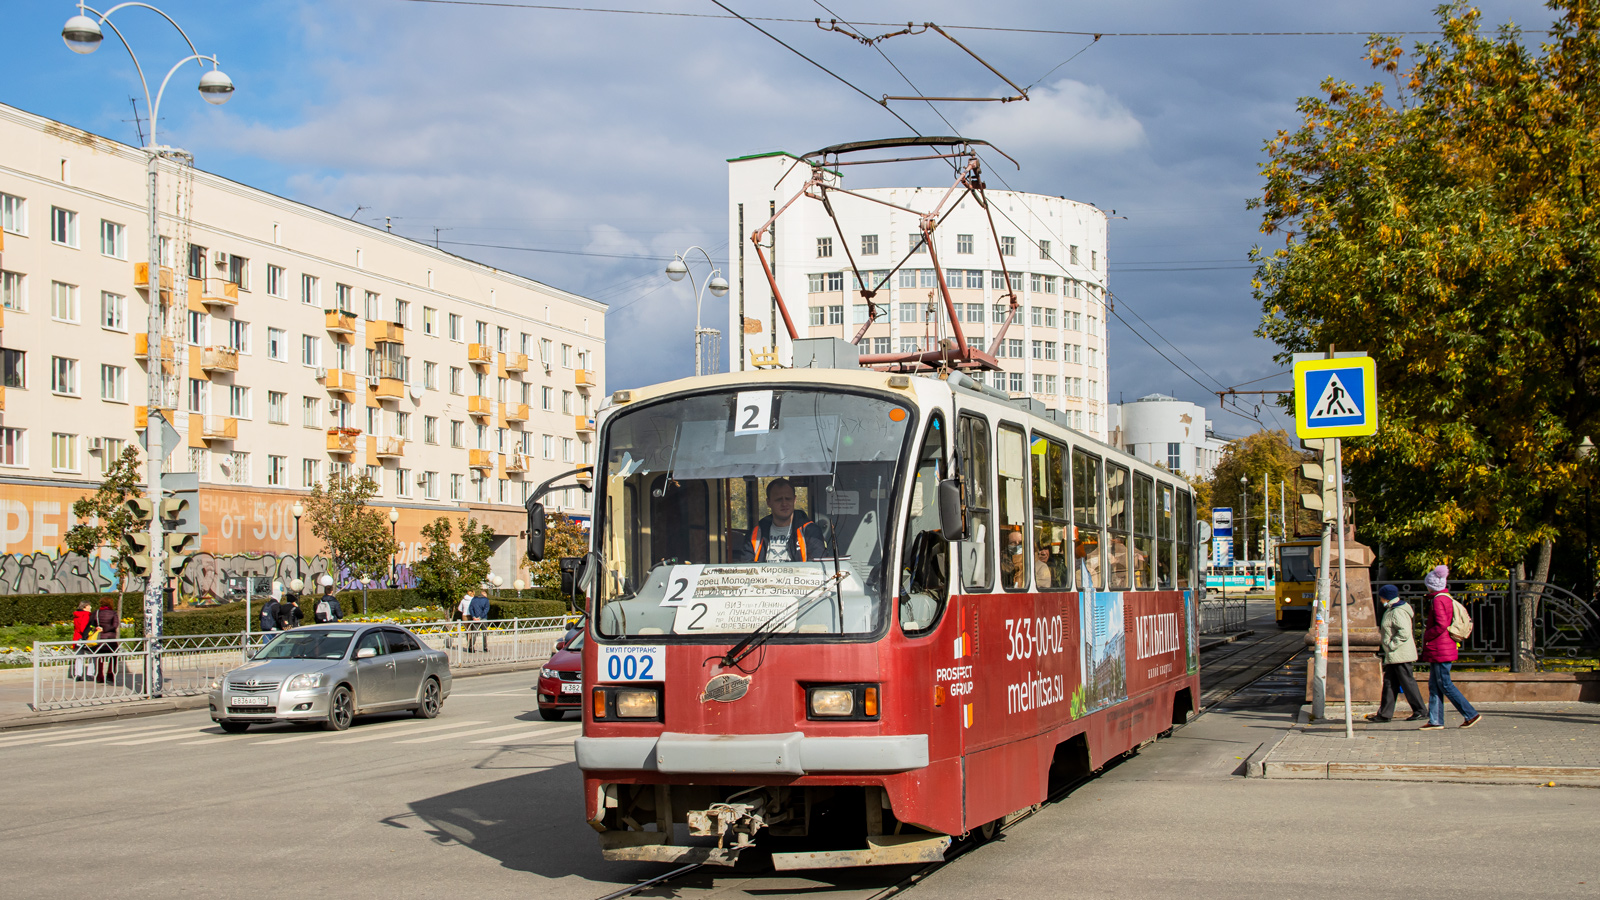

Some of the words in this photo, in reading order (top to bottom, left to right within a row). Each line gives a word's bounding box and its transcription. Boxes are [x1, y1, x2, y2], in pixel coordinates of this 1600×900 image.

[742, 405, 760, 429] 2
[221, 515, 246, 539] ОТ
[253, 503, 296, 541] 500
[761, 566, 793, 575] Кирова
[970, 547, 978, 586] 2
[668, 577, 689, 602] 2
[721, 576, 768, 586] Молодежи
[775, 577, 792, 586] ж/д
[687, 602, 708, 631] 2
[1005, 614, 1064, 662] 363-00-02
[1135, 612, 1180, 661] МЕЛЬНИЦА
[605, 646, 623, 654] ЕМУП
[623, 646, 657, 654] ГОРТРАНС
[607, 654, 654, 680] 002
[936, 665, 973, 682] PROSPECT
[950, 681, 974, 697] GROUP
[1008, 670, 1064, 715] melnitsa.su
